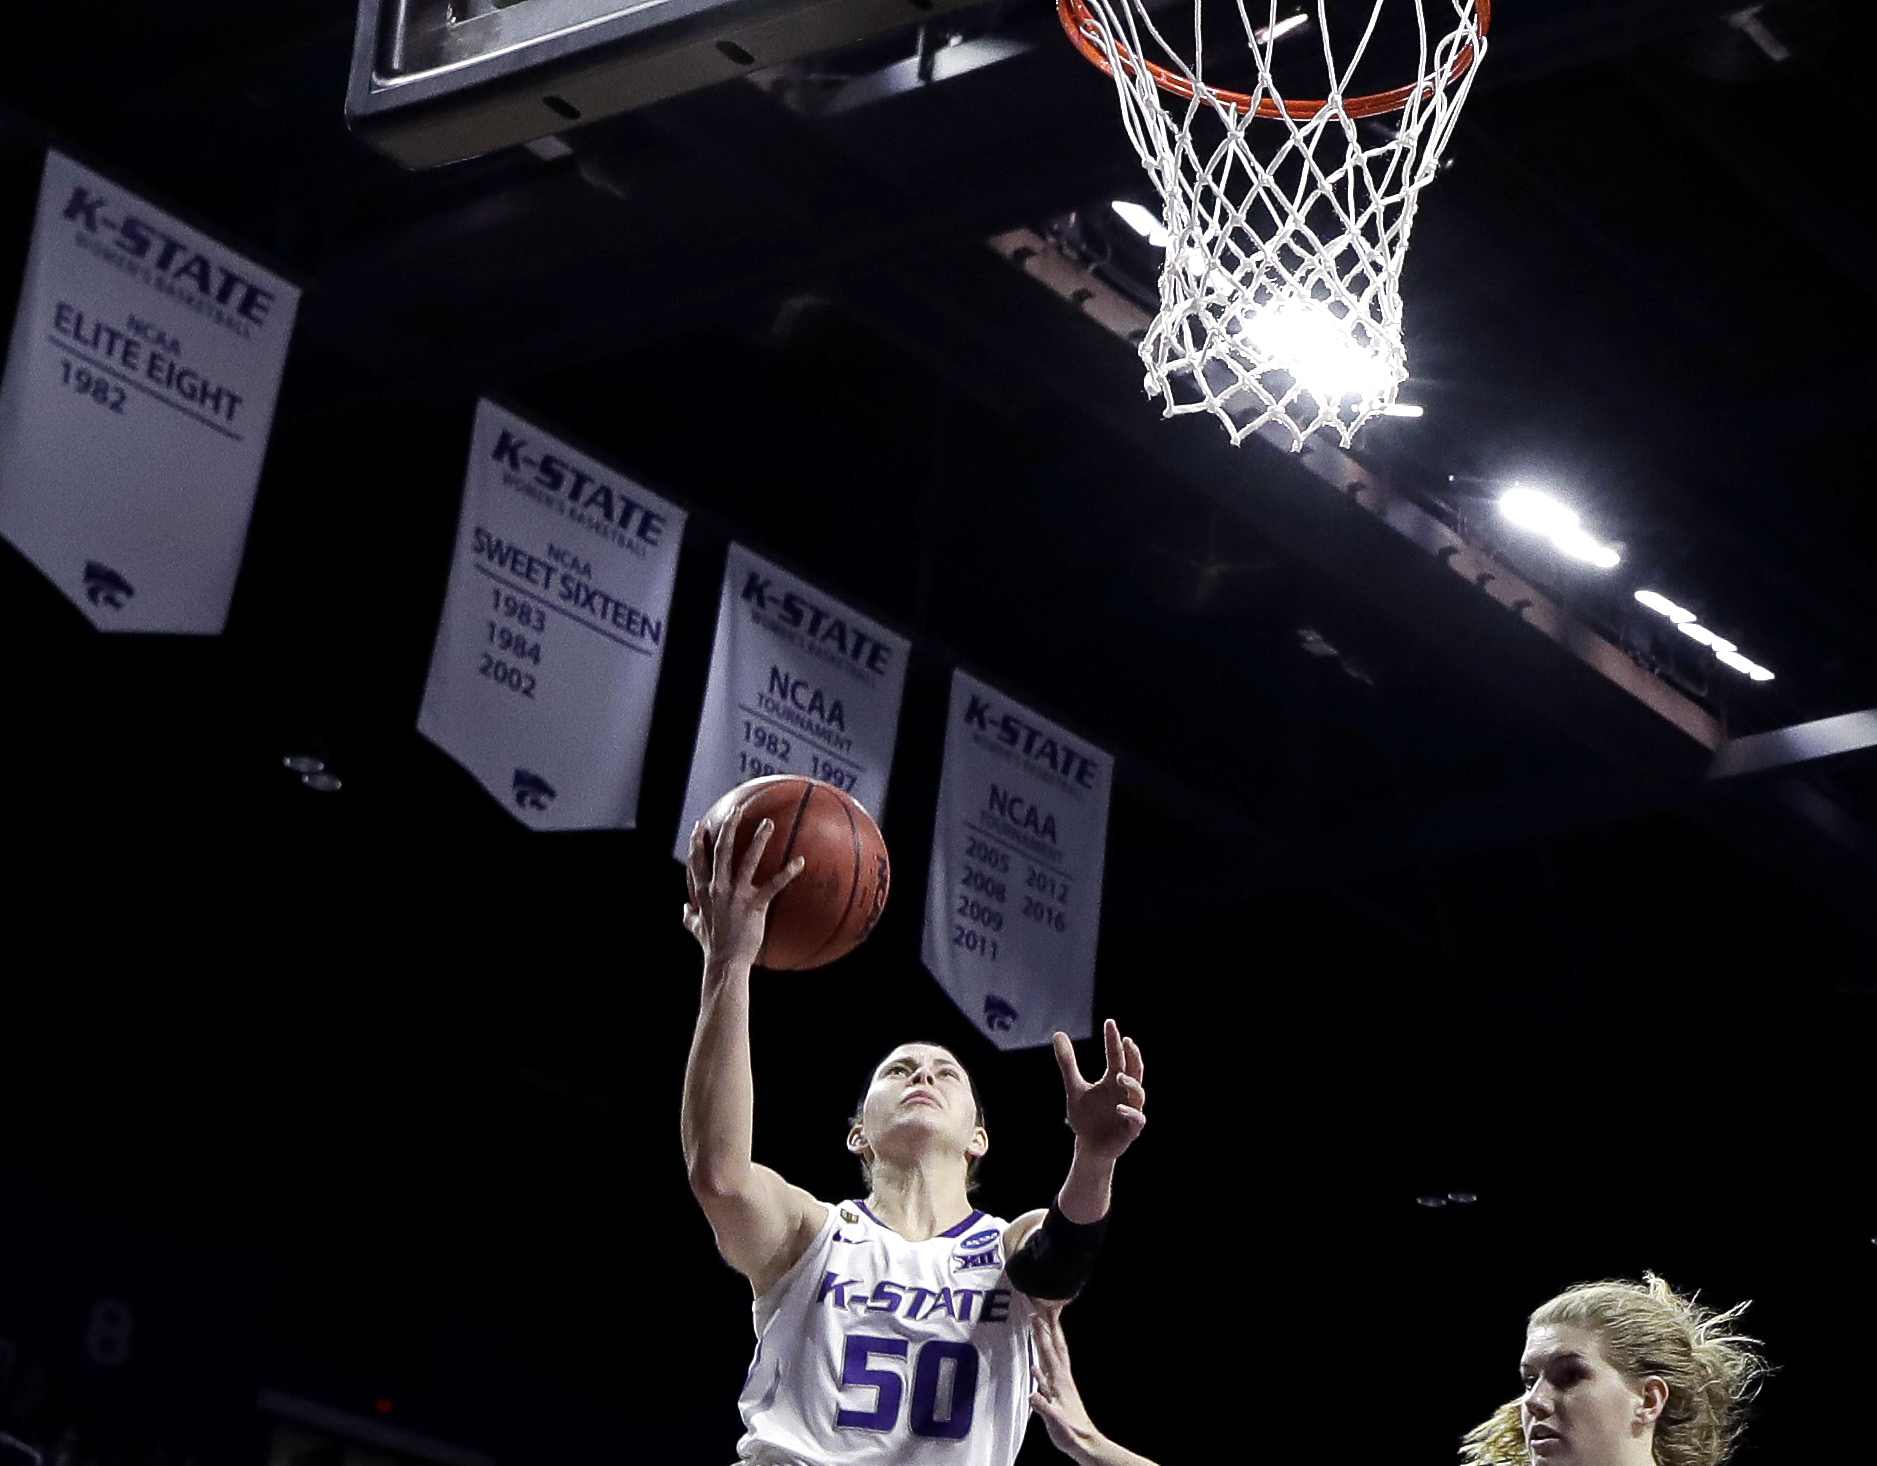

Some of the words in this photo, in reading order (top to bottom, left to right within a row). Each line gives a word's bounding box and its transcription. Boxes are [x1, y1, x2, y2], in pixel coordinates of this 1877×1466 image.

[63, 186, 275, 328] K-STATE
[54, 300, 142, 371] ELITE
[147, 351, 243, 422] EIGHT
[126, 313, 181, 357] NCAA
[61, 358, 126, 414] 1982
[492, 429, 668, 547] K-STATE
[473, 526, 556, 590] SWEET
[558, 573, 663, 644] SIXTEEN
[547, 542, 592, 580] NCAA
[493, 587, 547, 634] 1983
[740, 571, 893, 676] K-STATE
[488, 620, 542, 666] 1984
[479, 651, 537, 700] 2002
[769, 664, 846, 733] NCAA
[757, 692, 853, 753] TOURNAMENT
[965, 694, 1097, 789] K-STATE
[744, 720, 791, 762] 1982
[812, 755, 858, 794] 1997
[989, 783, 1057, 845] NCAA
[1022, 896, 1065, 932] 2016
[1025, 866, 1068, 905] 2012
[953, 926, 998, 960] 2011
[816, 1272, 1011, 1323] K-STATE
[834, 1333, 980, 1440] 50
